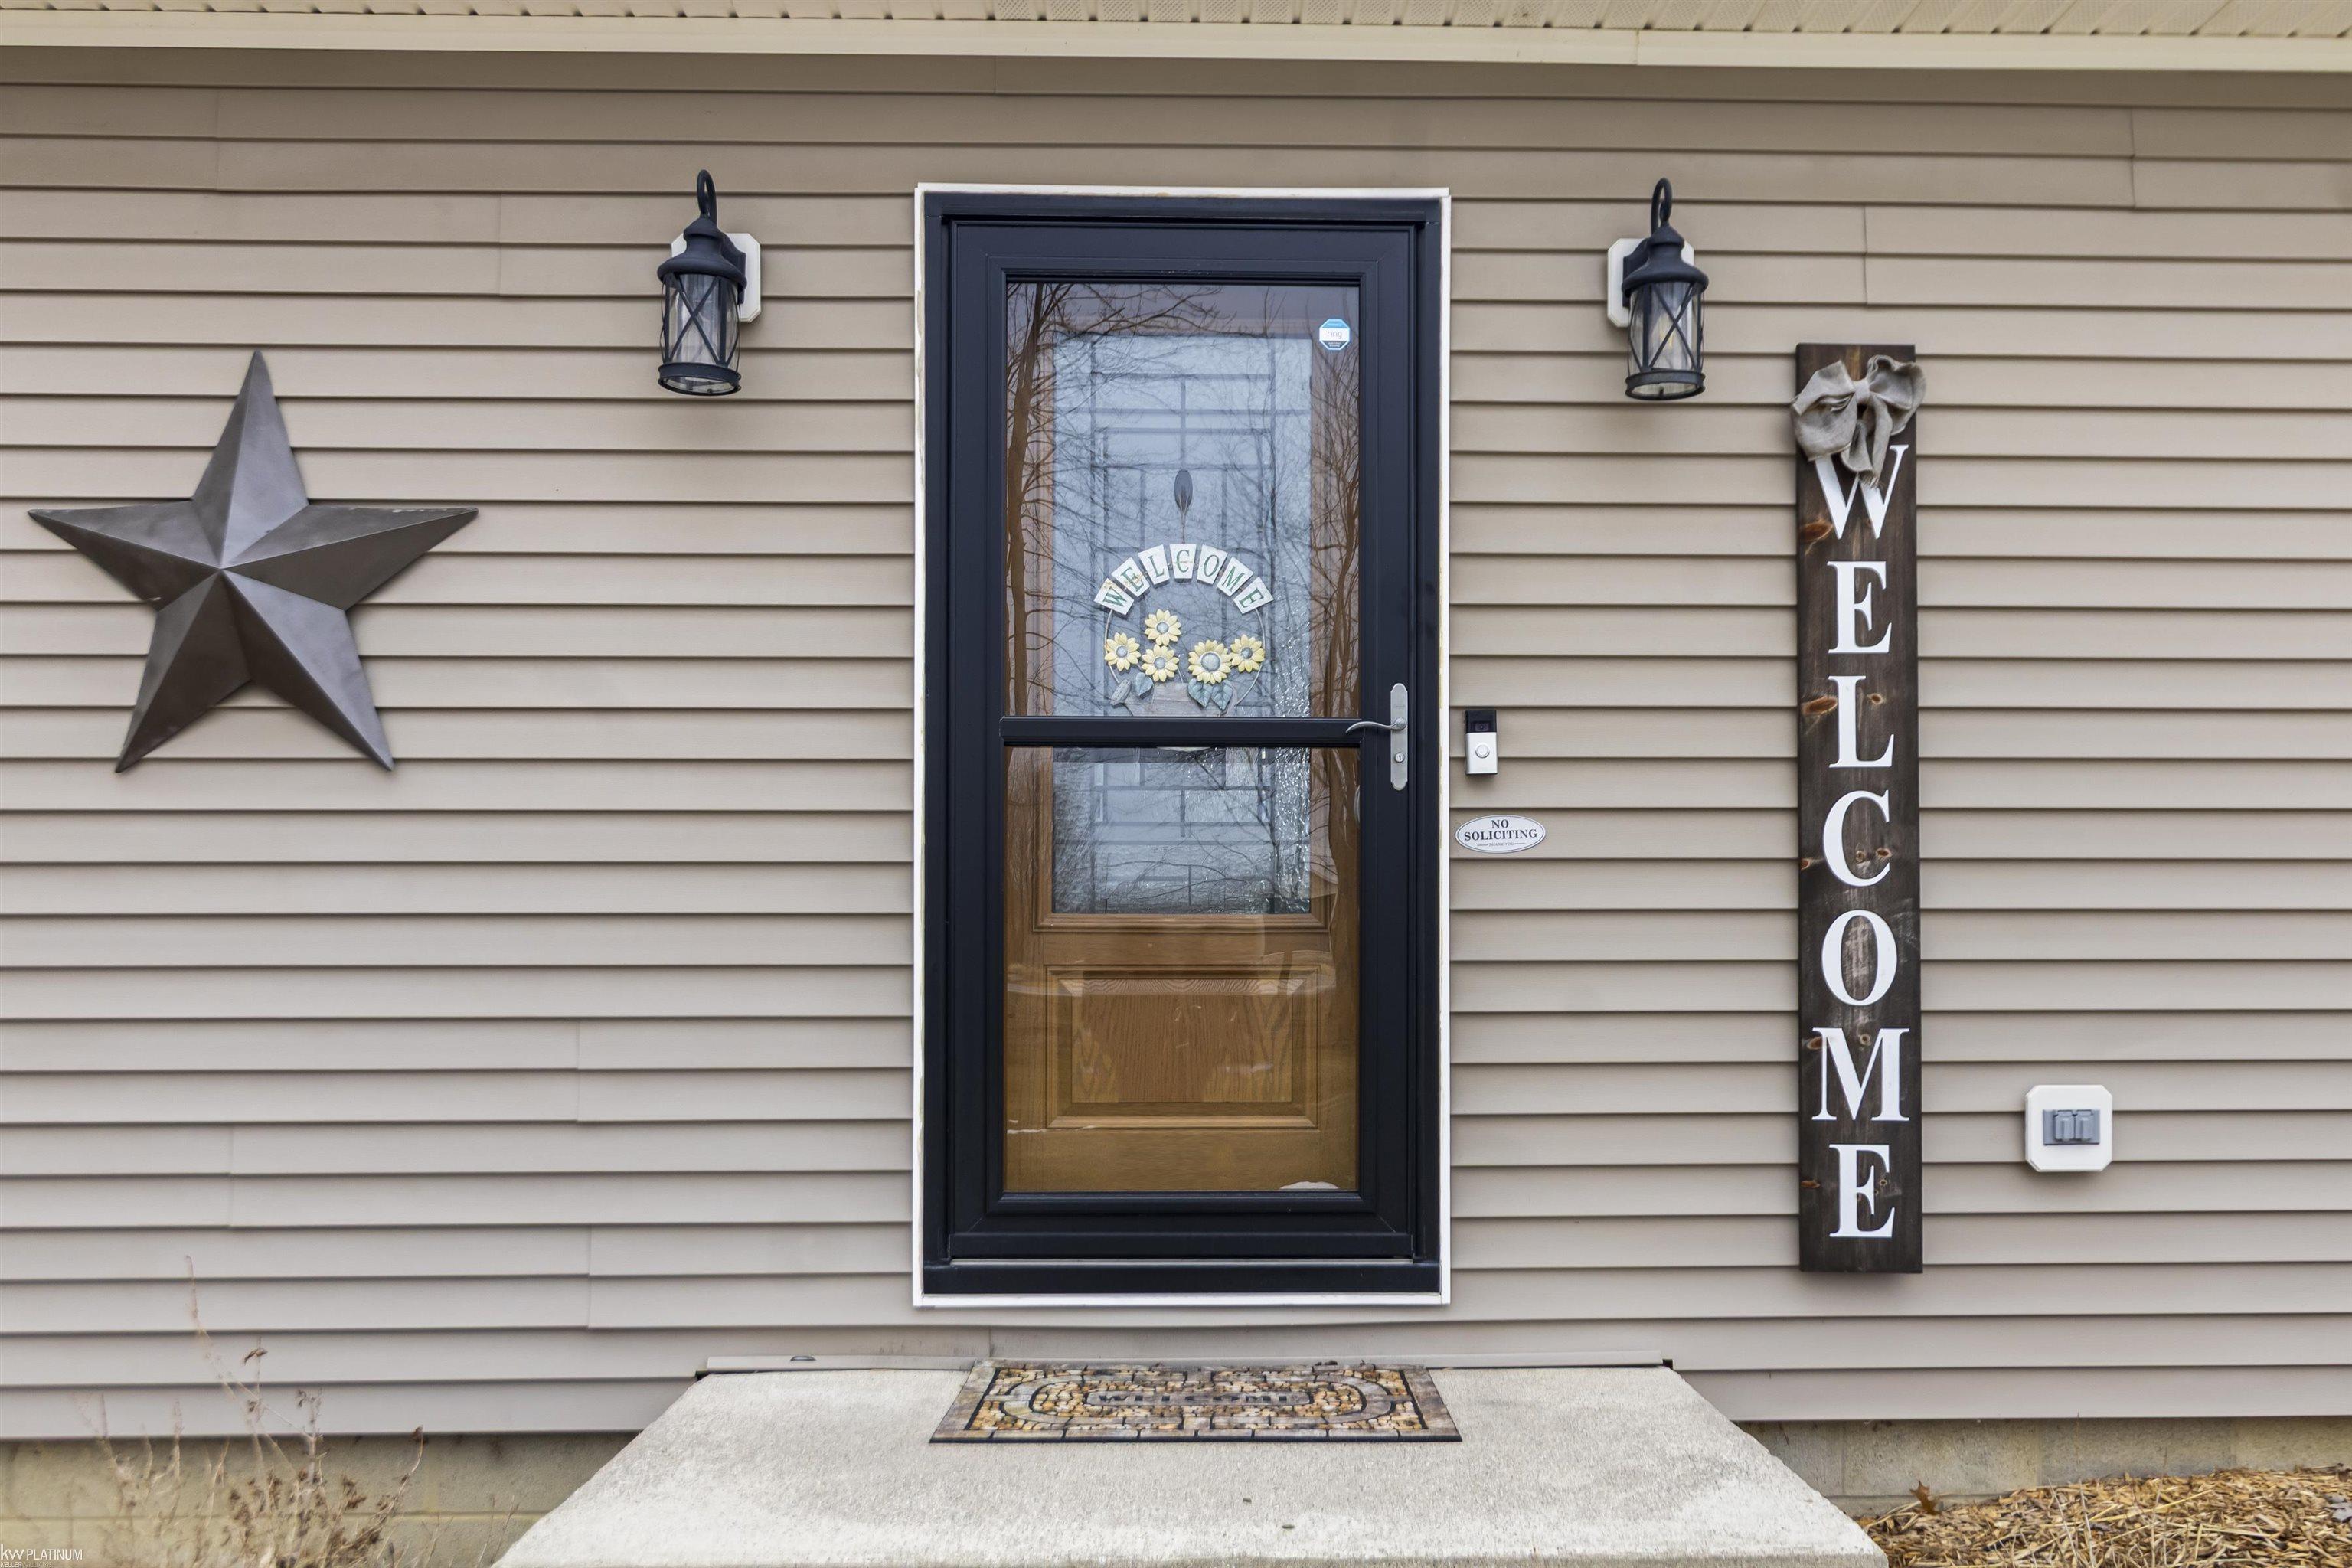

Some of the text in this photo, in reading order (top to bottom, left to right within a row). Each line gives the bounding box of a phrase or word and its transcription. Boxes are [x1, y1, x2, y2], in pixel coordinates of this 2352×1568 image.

[1327, 331, 1342, 339] ring
[1102, 549, 1265, 609] WELCOME
[1491, 819, 1509, 828] NO
[1464, 828, 1537, 841] SOLICITING
[1811, 444, 1910, 1238] WELCOME
